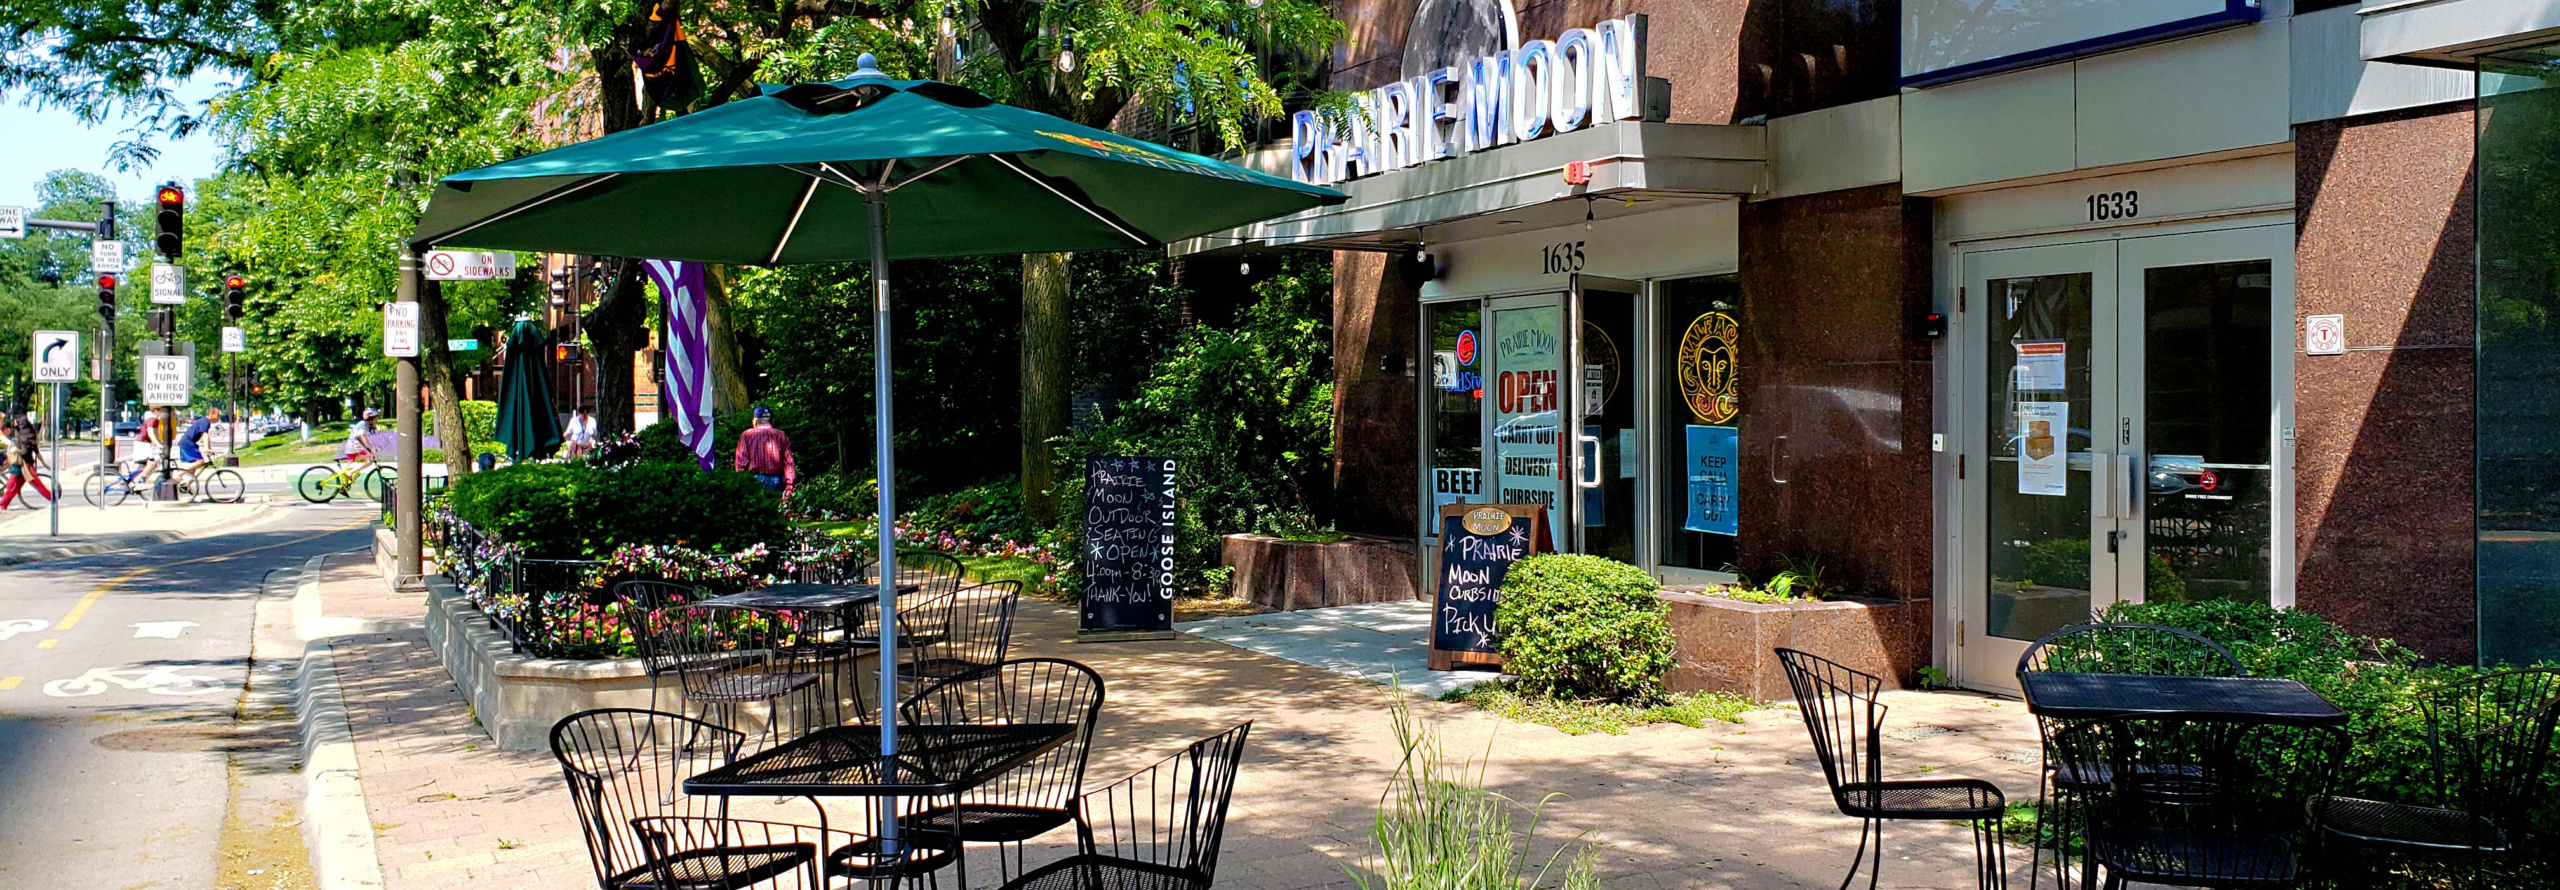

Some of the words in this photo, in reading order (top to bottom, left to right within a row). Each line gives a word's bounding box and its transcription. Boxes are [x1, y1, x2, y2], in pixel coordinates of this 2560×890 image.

[1293, 67, 1459, 186] PRAIRIE
[1465, 13, 1648, 152] MOON
[0, 208, 19, 216] ONE
[2087, 190, 2138, 221] 1633
[481, 254, 493, 265] ON
[1541, 240, 1586, 274] 1635
[464, 266, 510, 277] SIDEWALKS
[154, 288, 181, 297] SIGNAL
[395, 307, 408, 317] NO
[387, 319, 416, 328] PARKING
[2320, 329, 2328, 341] T
[1500, 329, 1530, 358] PRAIRIE
[1531, 329, 1557, 355] MOON
[40, 367, 71, 377] ONLY
[157, 362, 176, 371] NO
[154, 373, 179, 381] TURN
[147, 383, 160, 391] ON
[166, 383, 185, 391] RED
[1499, 370, 1557, 414] OPEN
[149, 393, 183, 401] ARROW
[1500, 424, 1535, 444] CARRY
[1536, 425, 1556, 445] OUT
[1505, 456, 1552, 477] DELIVERY
[1700, 455, 1727, 469] KEEP
[1091, 461, 1147, 487] PRAIRIE
[1699, 470, 1727, 484] CALM
[1162, 460, 1176, 527] ISLAND
[1502, 488, 1555, 511] CURBSIDE
[1697, 493, 1730, 508] CARRY
[1089, 506, 1157, 525] OUTDOOR
[1473, 511, 1504, 520] PRAIRIE
[1703, 510, 1725, 523] OUT
[1091, 524, 1159, 545] SEATING
[1472, 522, 1500, 532] MOON
[1106, 543, 1150, 564] OPEN
[1459, 535, 1522, 561] PRAIRIE
[1160, 535, 1174, 599] GOOSE
[1449, 563, 1490, 584] MOON
[1449, 585, 1501, 602] CURBSID
[1483, 613, 1498, 635] U
